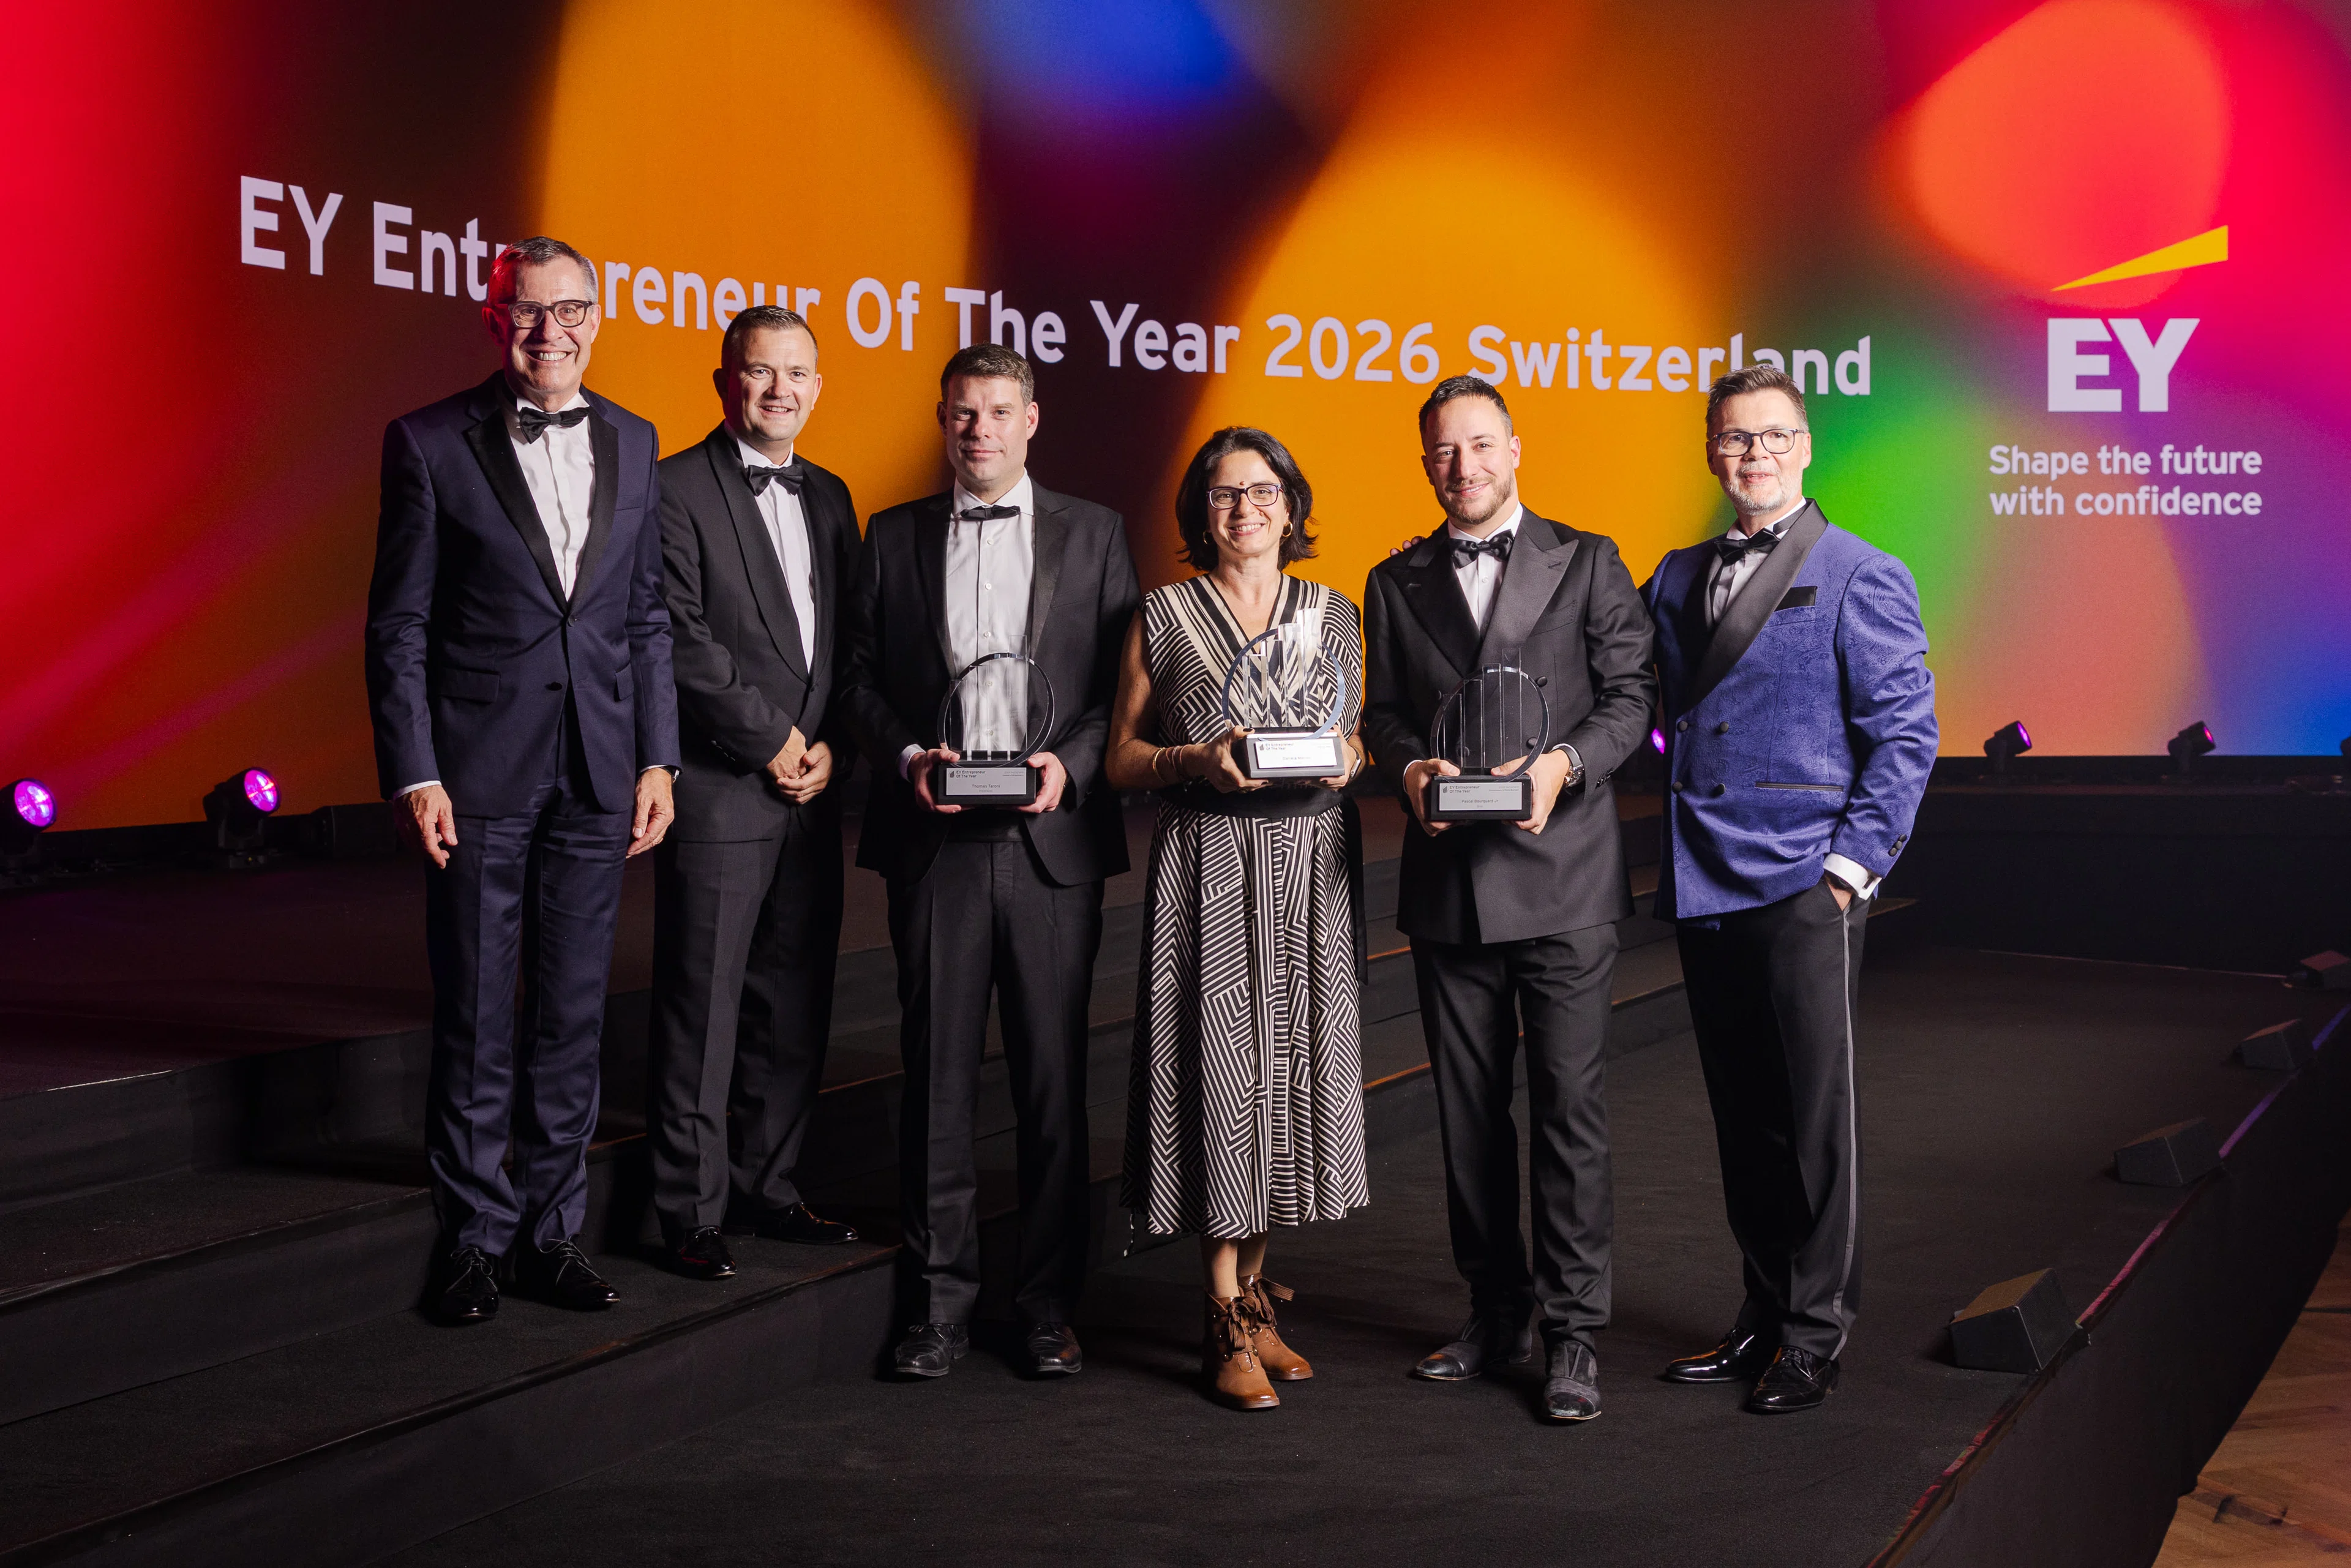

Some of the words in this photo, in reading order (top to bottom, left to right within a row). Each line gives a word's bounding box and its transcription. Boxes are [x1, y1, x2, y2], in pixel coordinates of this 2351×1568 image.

[241, 175, 343, 276] EY
[373, 201, 821, 332] Entrener
[846, 277, 920, 351] Of
[945, 287, 1066, 364] The
[1090, 300, 1240, 373] Year
[1264, 313, 1440, 384] 2026
[2047, 318, 2200, 412] EY
[1989, 445, 2089, 481] Shape
[2096, 445, 2151, 475] the
[2160, 444, 2262, 475] future
[1989, 485, 2064, 516] with
[2075, 485, 2262, 516] confidence
